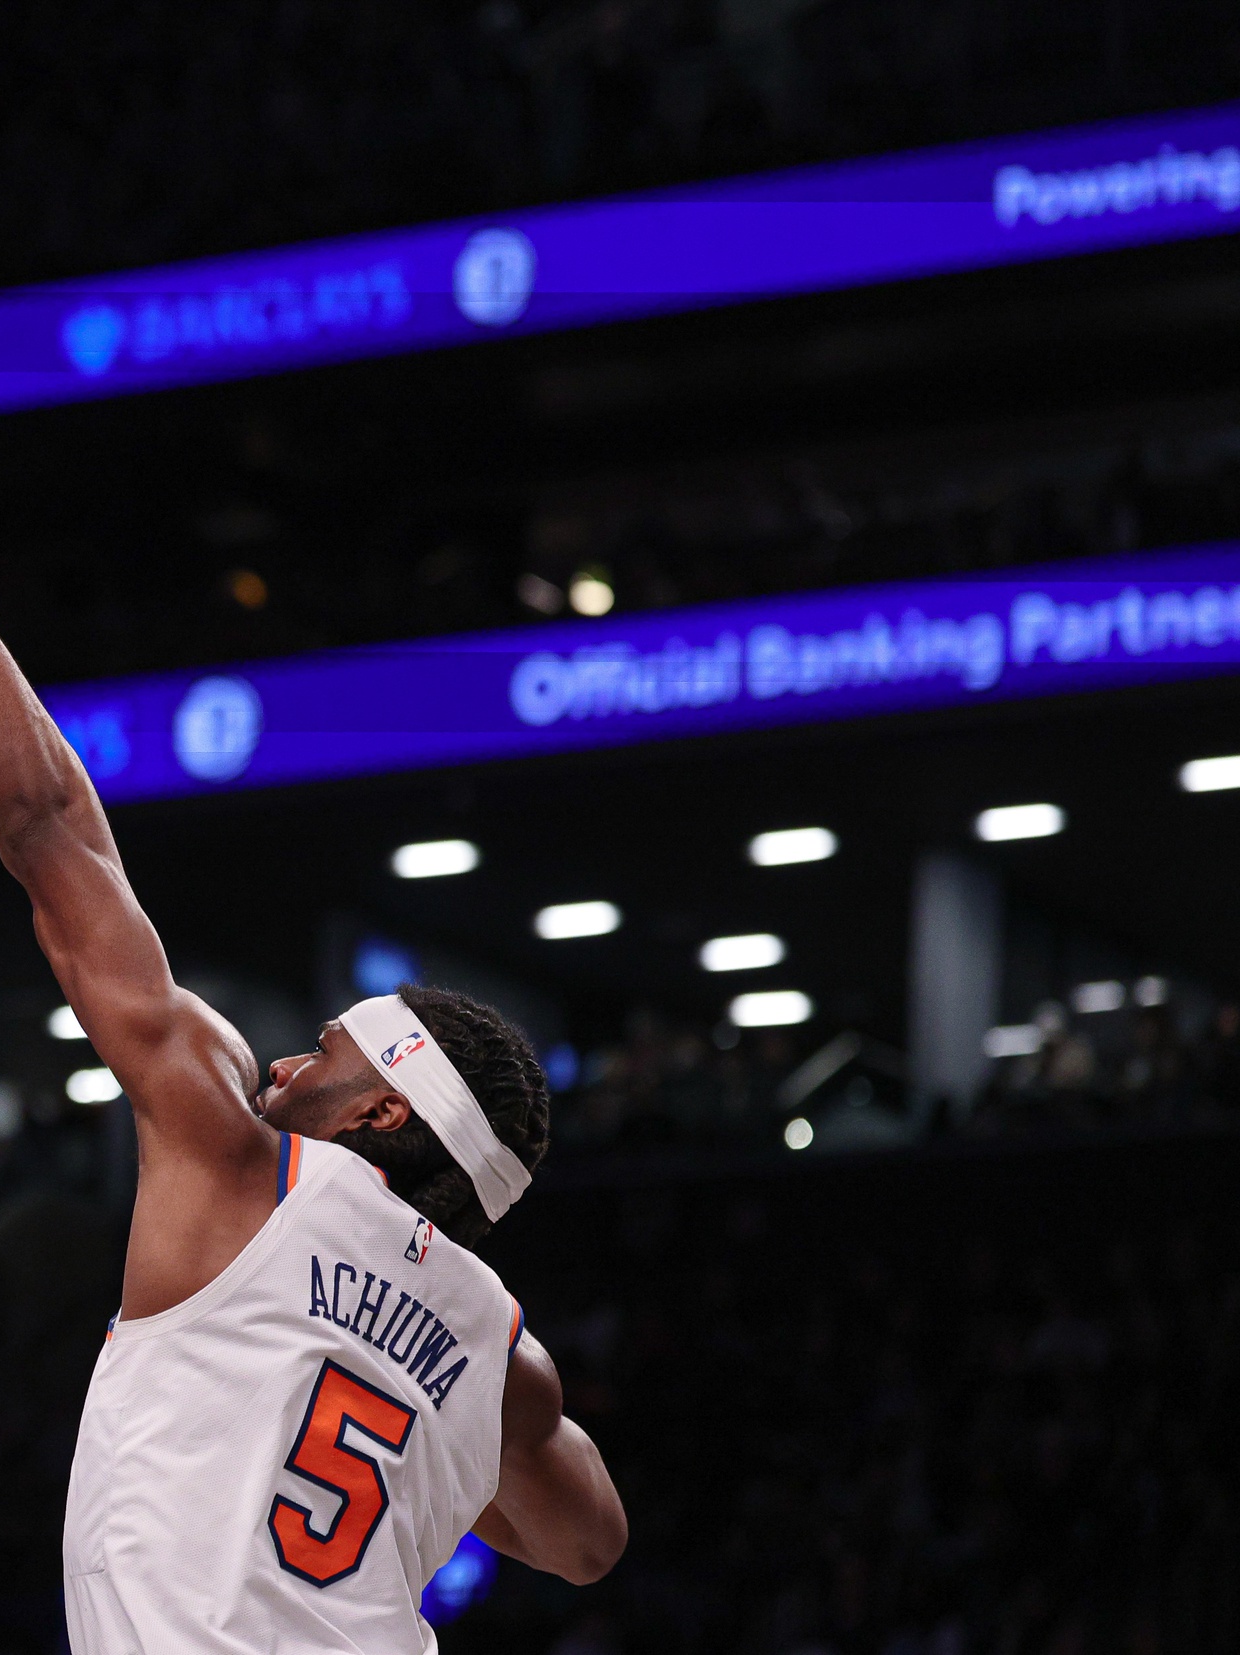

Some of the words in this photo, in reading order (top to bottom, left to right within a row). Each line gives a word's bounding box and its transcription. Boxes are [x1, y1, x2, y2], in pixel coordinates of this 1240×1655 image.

[511, 632, 740, 724] Official
[748, 610, 1003, 697] Banking
[309, 1255, 469, 1411] ACHIUWA
[268, 1357, 417, 1589] 5
